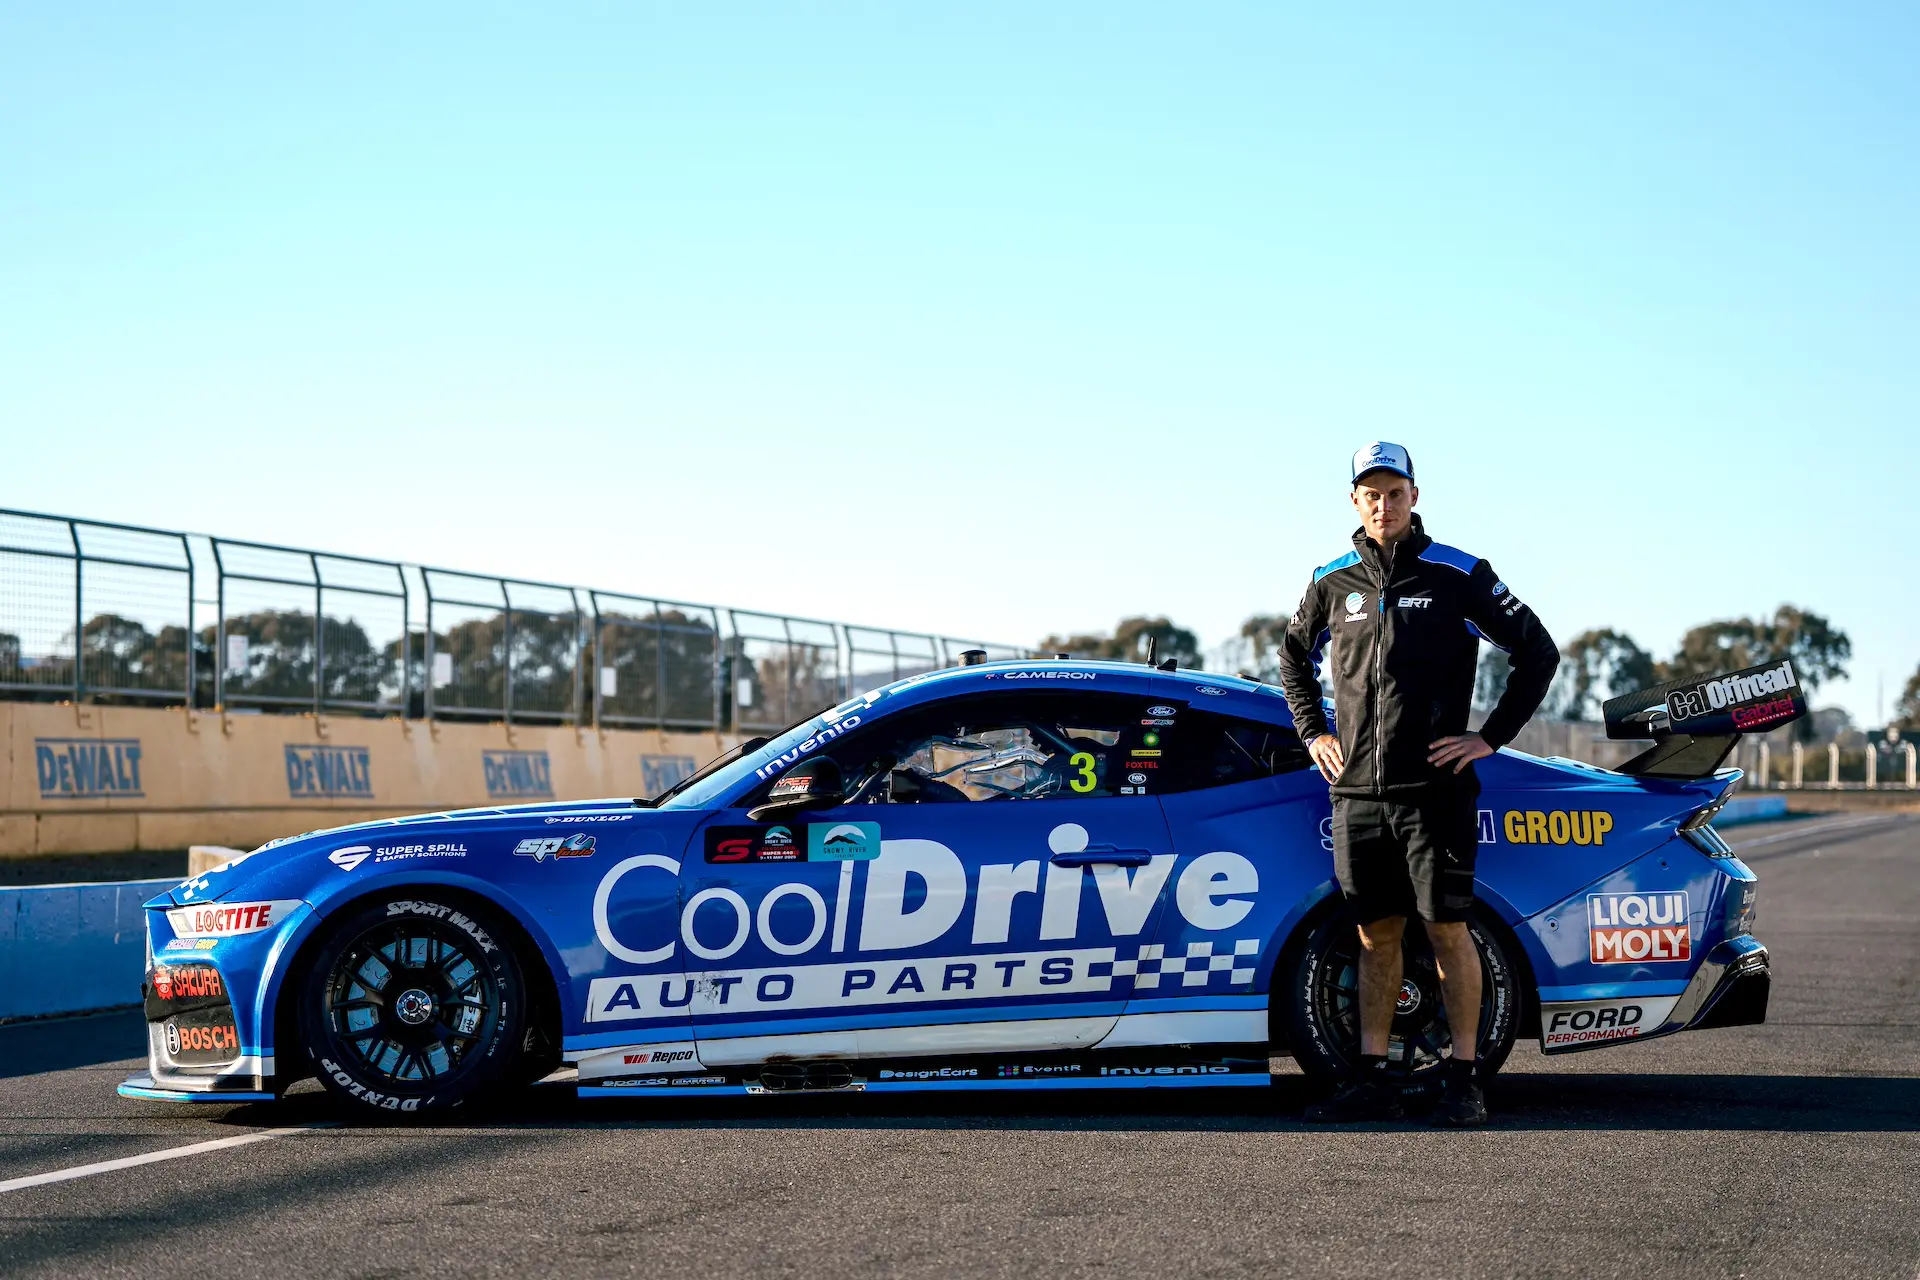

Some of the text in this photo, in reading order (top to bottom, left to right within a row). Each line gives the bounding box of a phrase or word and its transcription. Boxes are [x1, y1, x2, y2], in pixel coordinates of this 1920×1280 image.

[1398, 597, 1432, 608] BRT
[1004, 672, 1096, 680] CAMERON
[1666, 661, 1796, 721] CalOffroad
[1731, 694, 1795, 723] Gabriel
[1069, 752, 1097, 792] 3
[1504, 810, 1613, 845] GROUP
[376, 844, 467, 857] SUPER SPILL
[383, 853, 414, 861] SAFETY
[593, 822, 1259, 964] CoolDrive
[196, 905, 271, 932] LOCTITE
[1593, 895, 1683, 926] LIQUI
[386, 901, 498, 953] SPORT MAXX
[1595, 928, 1687, 960] MOLY
[605, 956, 1073, 1012] AUTO PARTS
[1549, 1005, 1643, 1032] FORD
[180, 1026, 237, 1050] BOSCH
[1546, 1026, 1640, 1043] PERFORMANCE
[651, 1050, 694, 1063] Repco
[1101, 1065, 1230, 1075] invenio
[322, 1059, 420, 1111] DUNLOP
[602, 1077, 668, 1087] sparco
[880, 1067, 978, 1078] DesignEars
